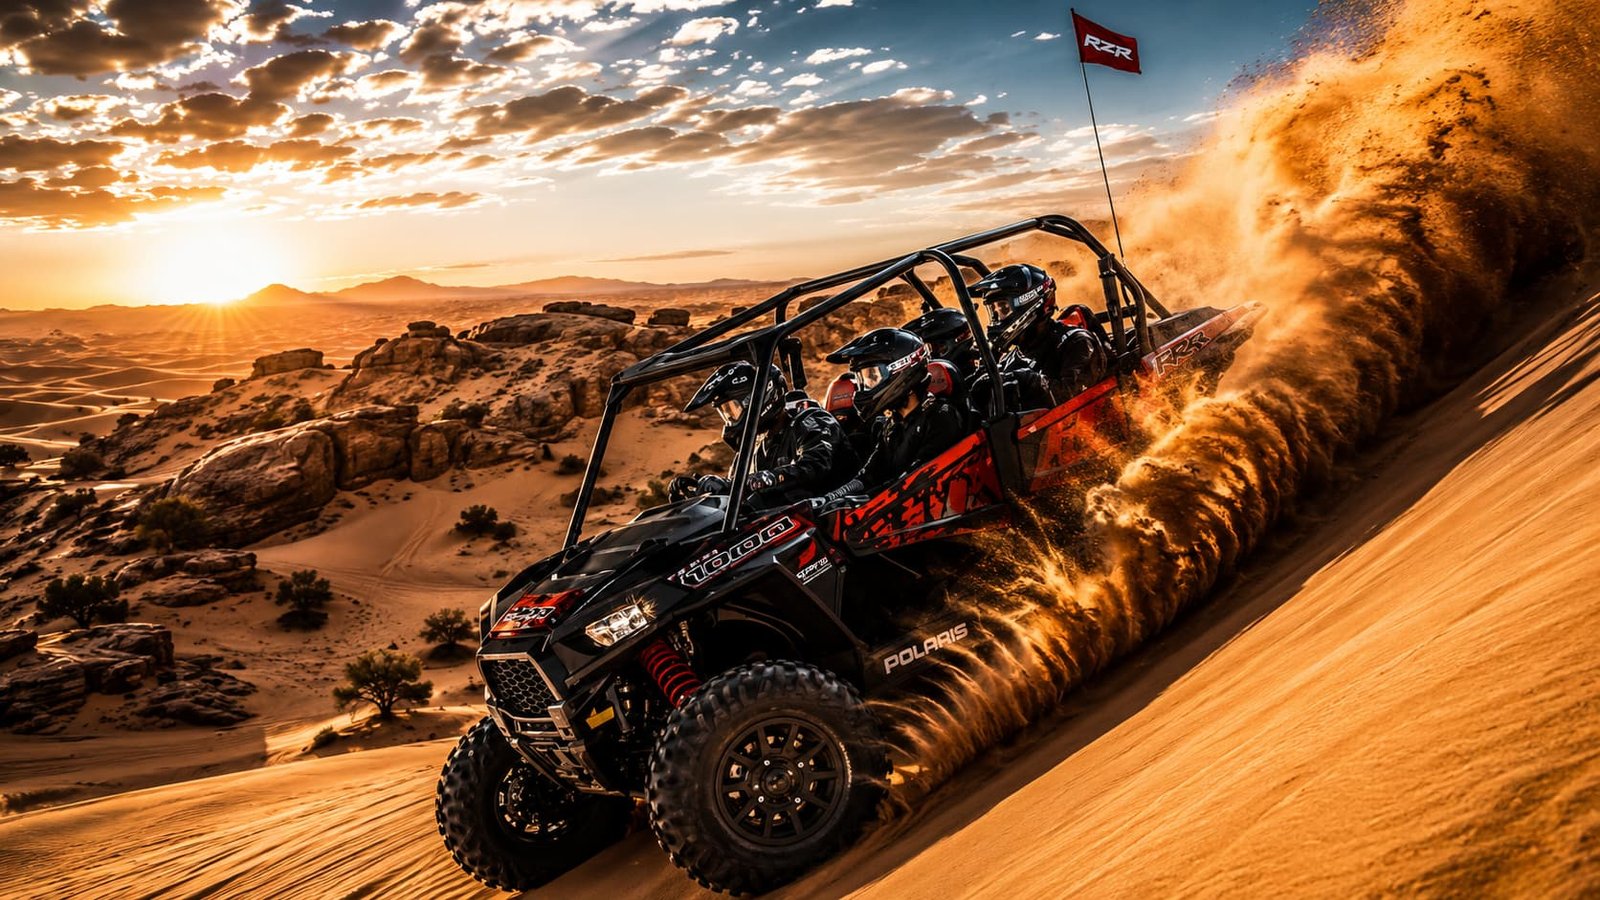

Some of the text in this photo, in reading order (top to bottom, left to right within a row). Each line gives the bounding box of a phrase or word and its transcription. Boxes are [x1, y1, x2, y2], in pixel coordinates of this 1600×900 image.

[1085, 34, 1133, 61] RZR
[681, 515, 795, 588] 1000
[883, 622, 968, 675] POLARIS
